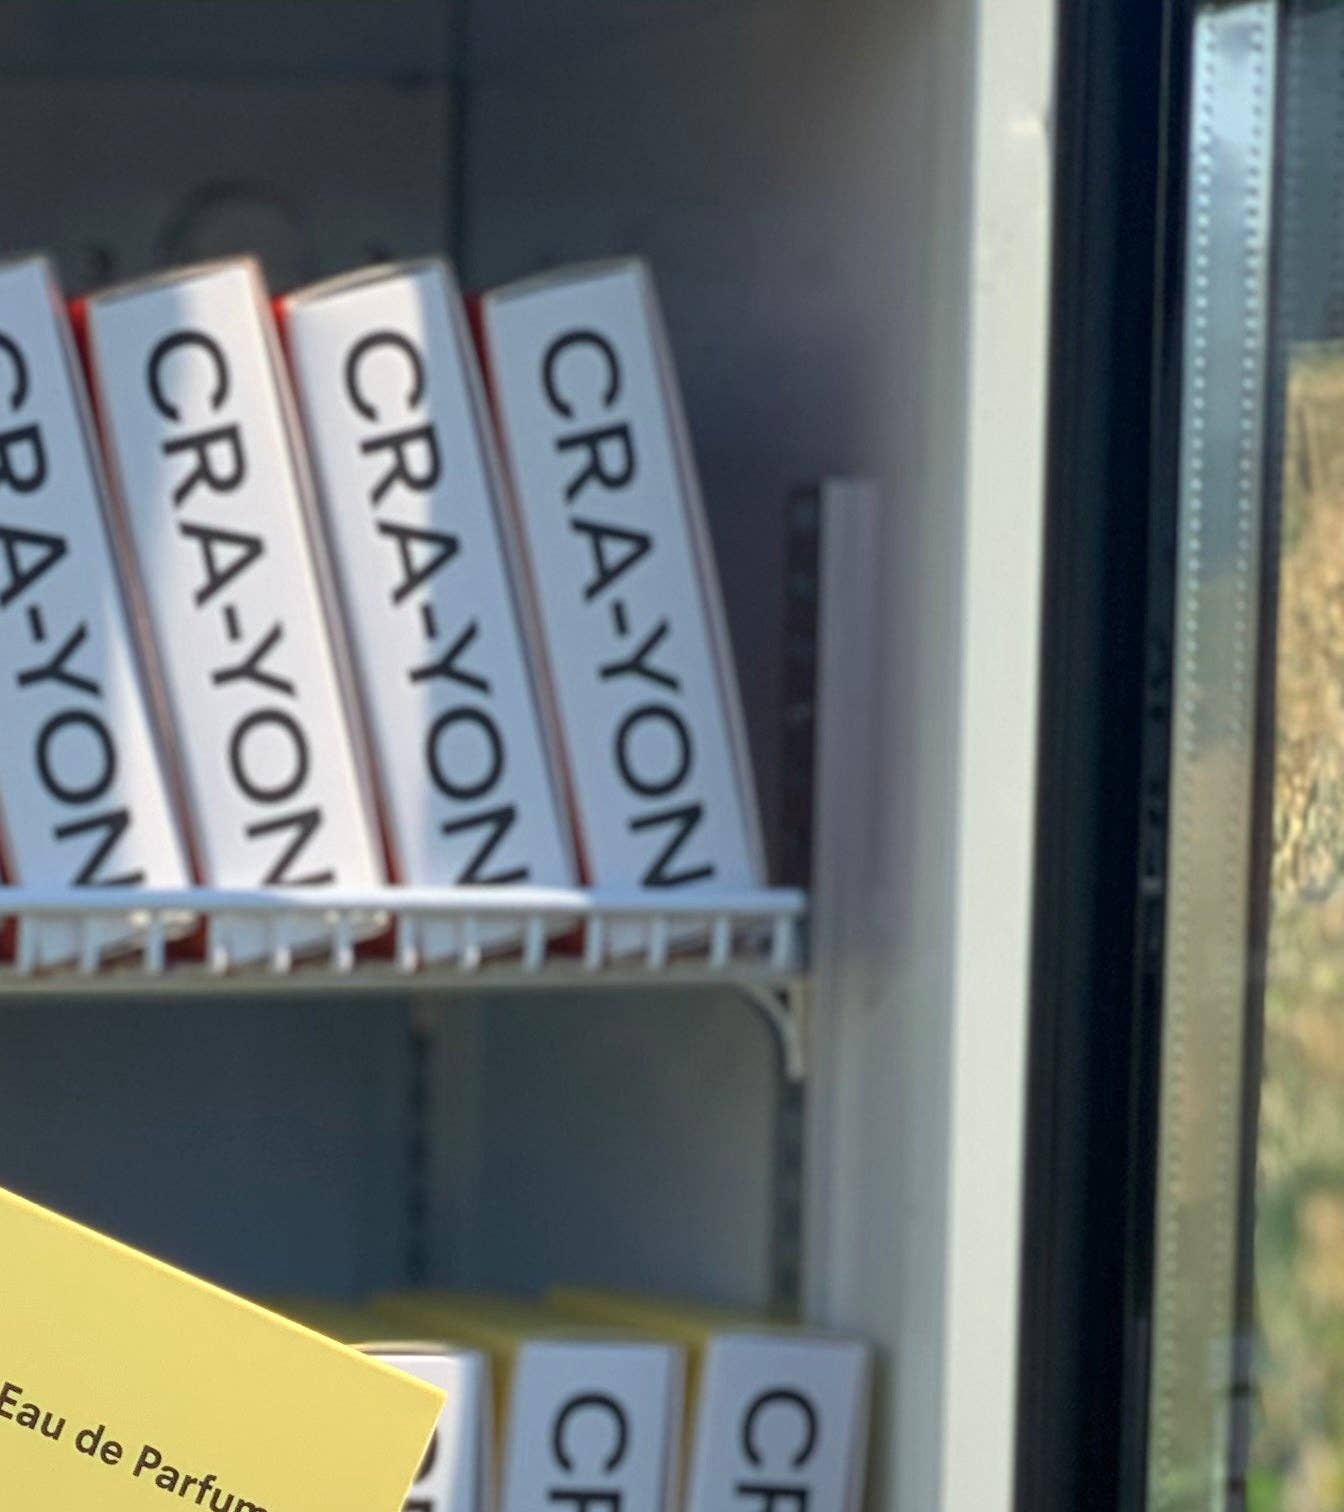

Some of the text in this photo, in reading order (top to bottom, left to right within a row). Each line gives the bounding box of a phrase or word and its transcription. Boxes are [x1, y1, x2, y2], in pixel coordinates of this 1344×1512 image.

[144, 329, 334, 886] CRA-YON
[343, 330, 530, 886] CRA-YON
[541, 329, 715, 888] CRA-YON
[74, 1423, 124, 1466] de
